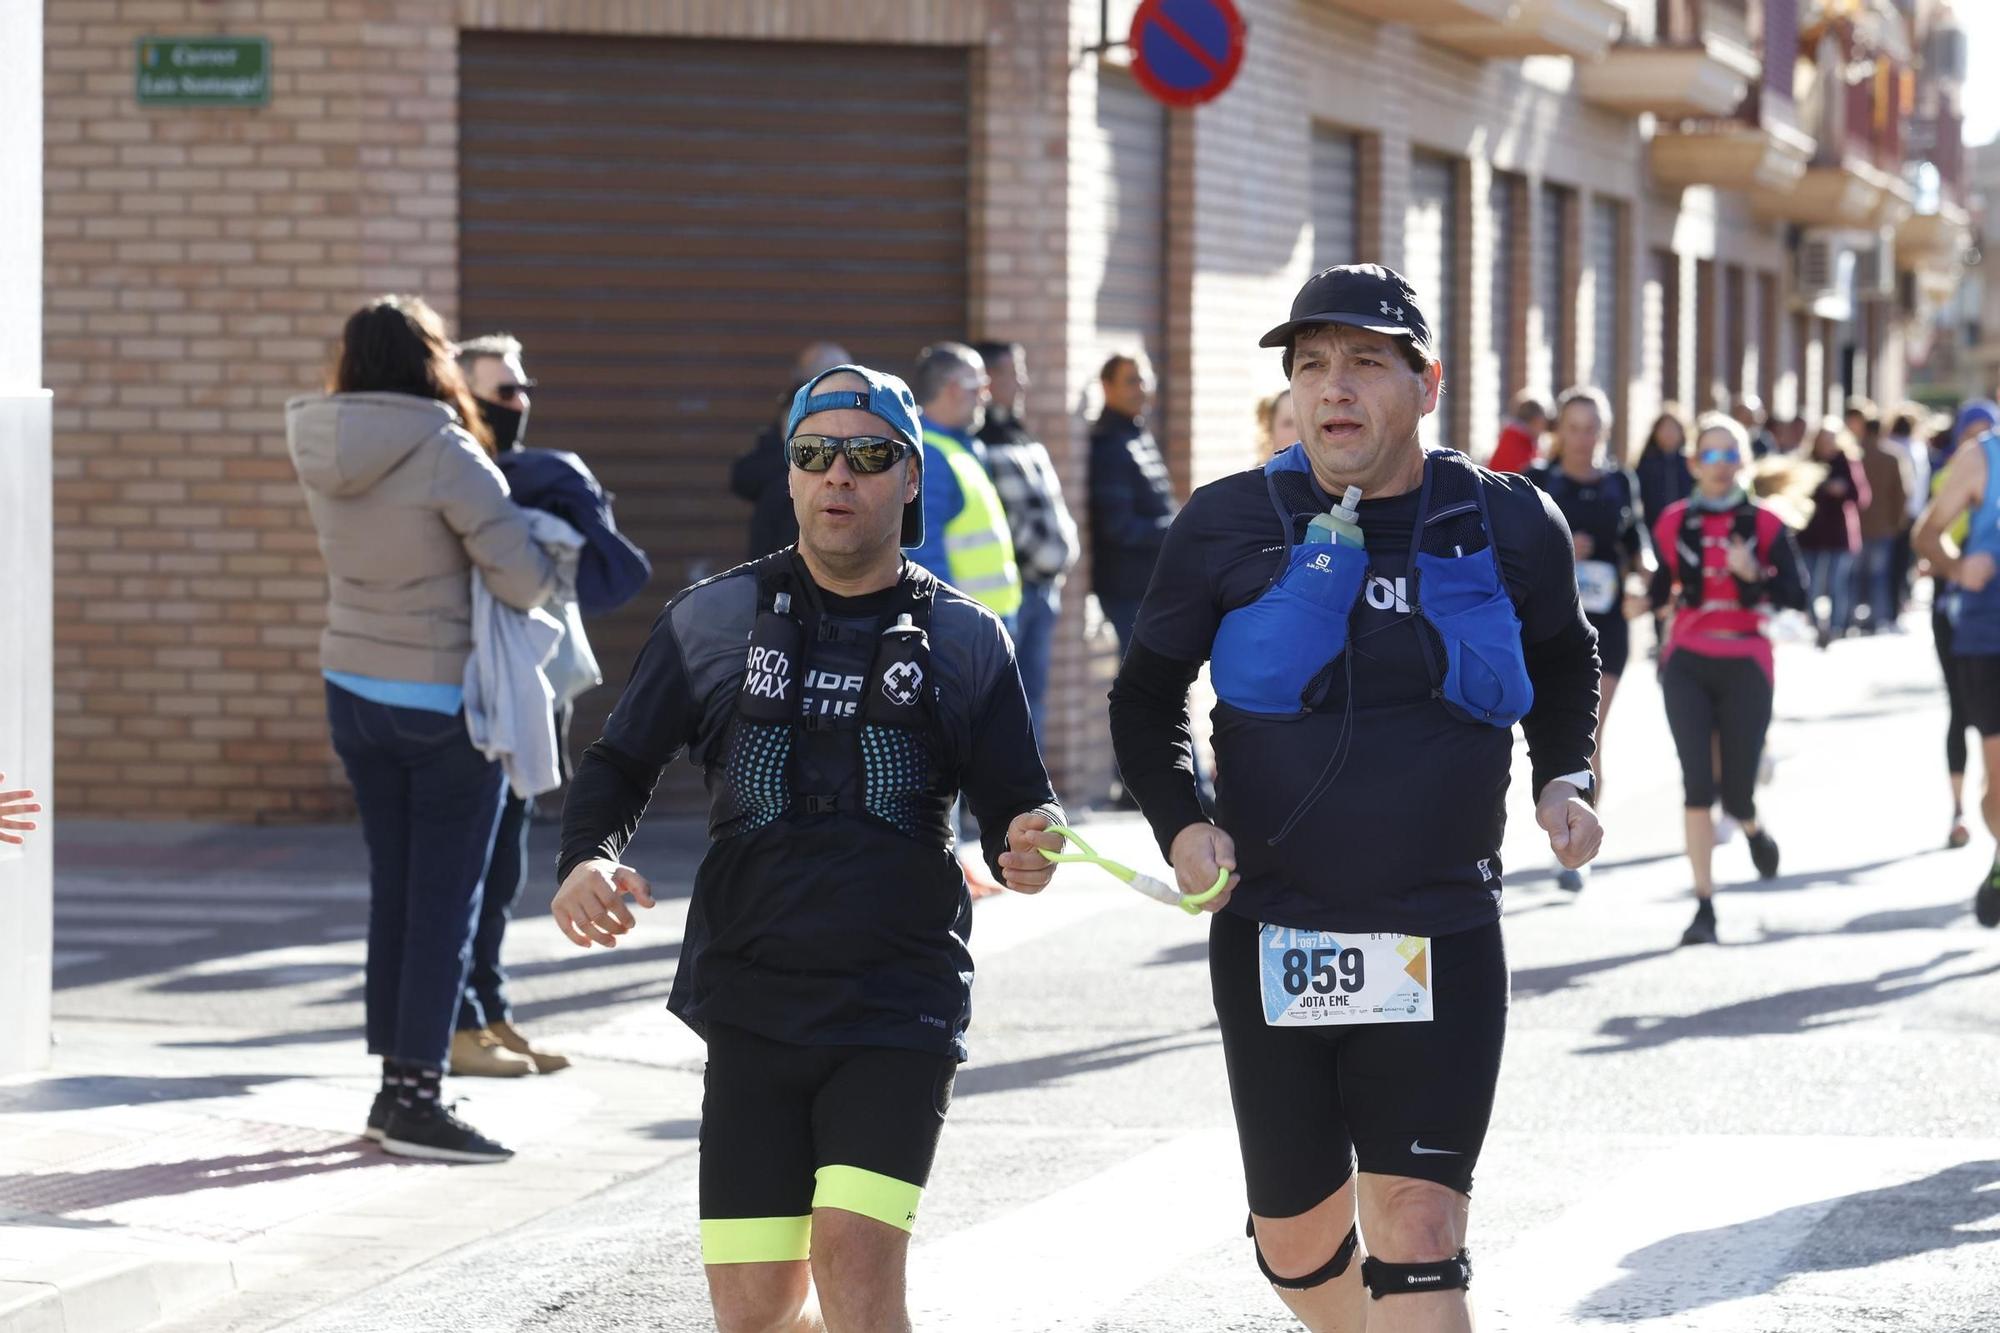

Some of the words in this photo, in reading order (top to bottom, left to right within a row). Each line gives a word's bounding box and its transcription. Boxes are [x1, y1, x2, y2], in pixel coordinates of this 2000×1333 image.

[742, 669, 792, 700] MAX
[1282, 947, 1365, 996] 859
[1300, 996, 1326, 1008] JOTA
[1329, 995, 1350, 1007] EME
